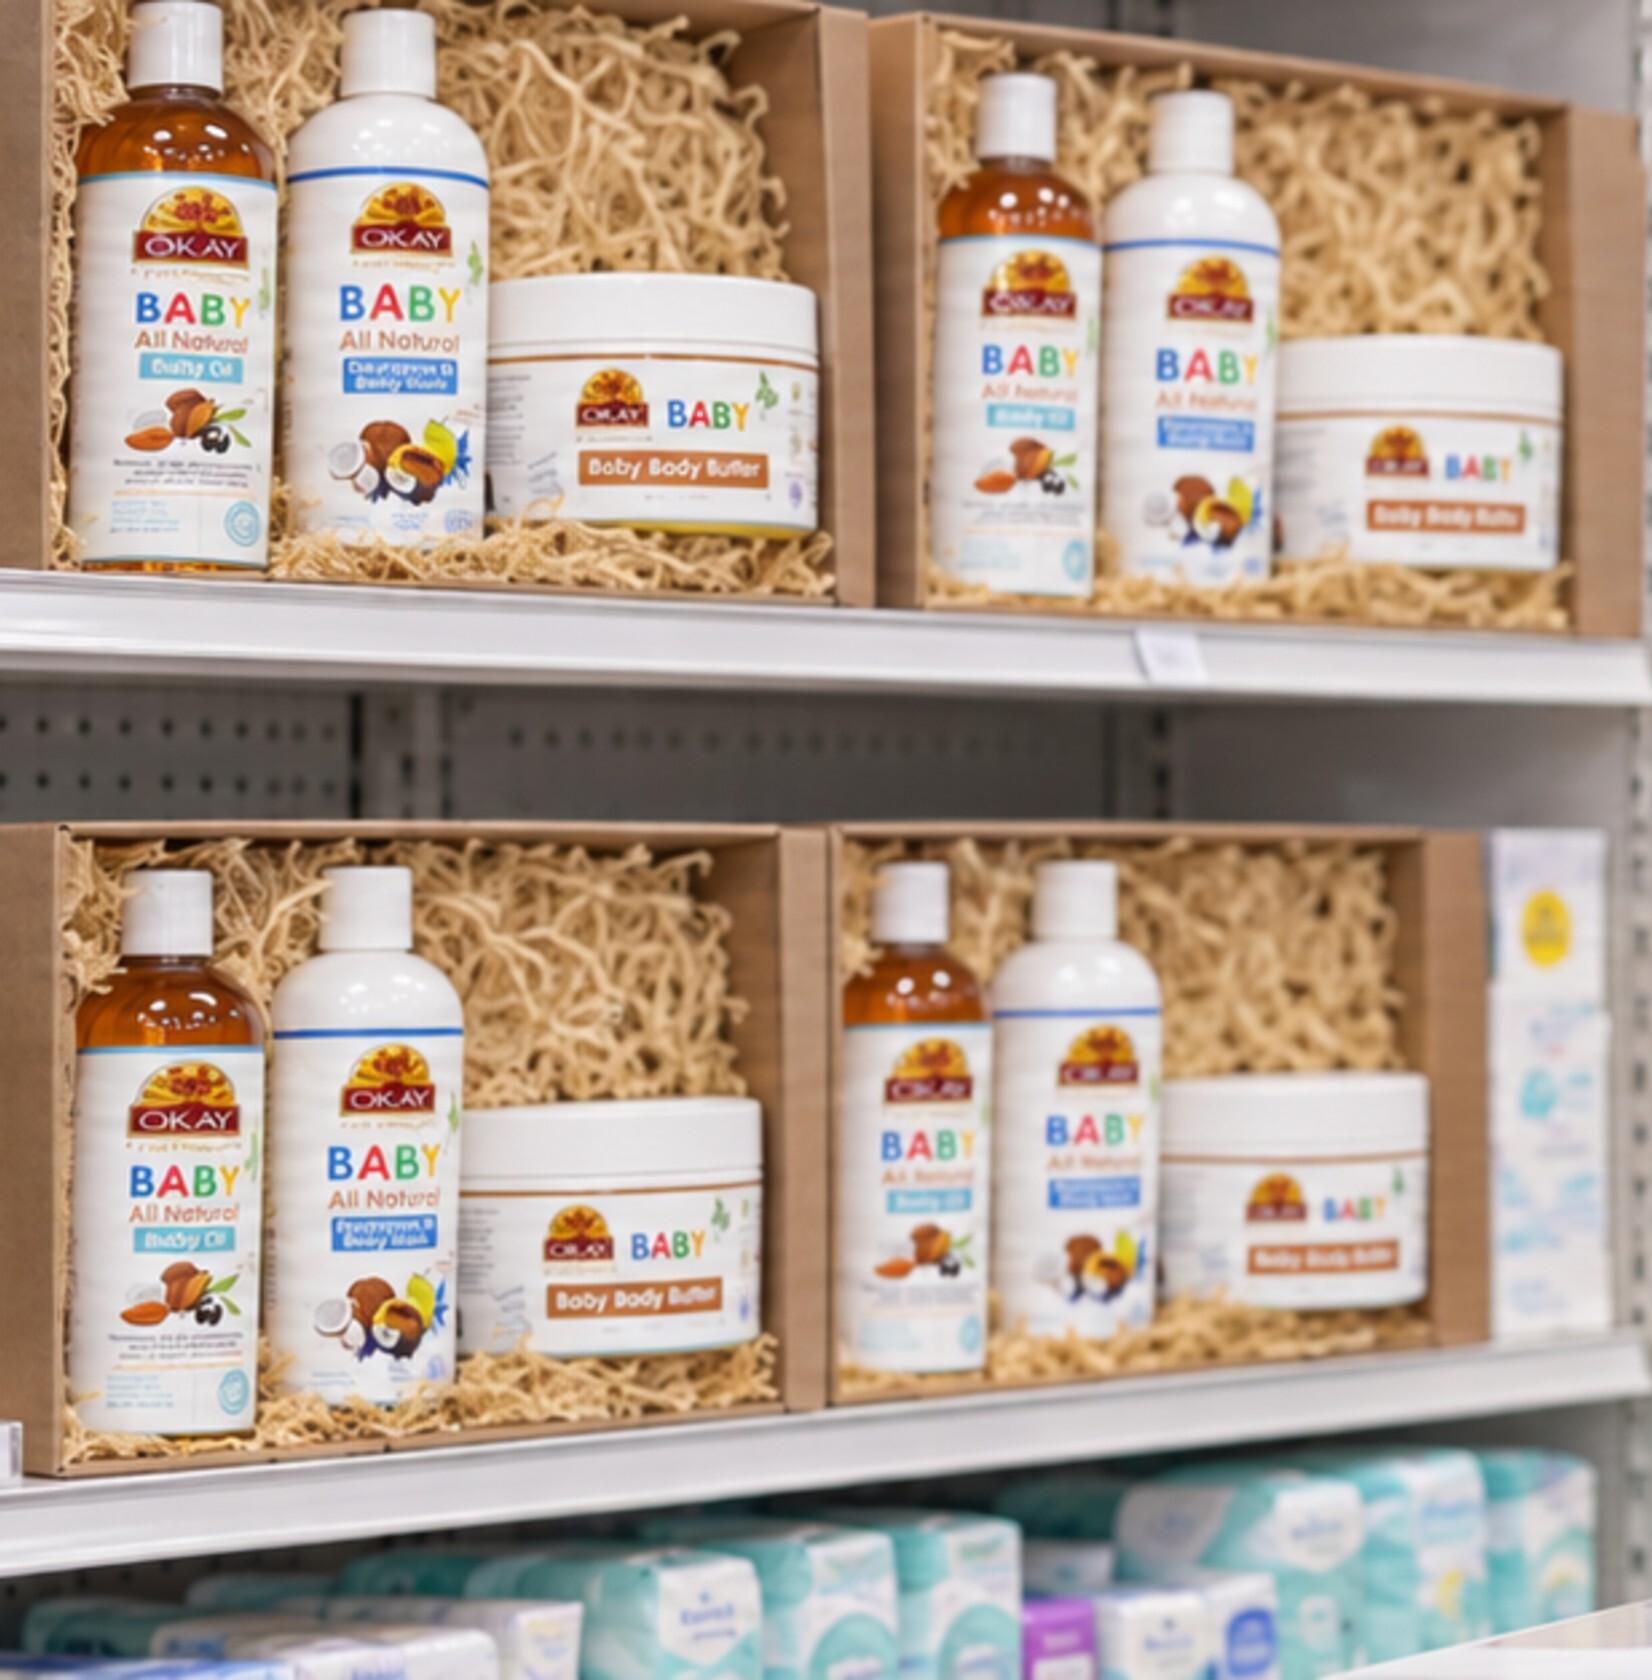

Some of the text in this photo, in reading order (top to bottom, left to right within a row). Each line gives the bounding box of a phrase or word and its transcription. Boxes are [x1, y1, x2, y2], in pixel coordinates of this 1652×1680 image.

[144, 235, 240, 258] OKAY
[361, 229, 444, 248] OKAY
[136, 292, 250, 327] BABY
[340, 283, 461, 323] BABY
[134, 330, 248, 354] All Natural
[339, 330, 460, 353] All Natural
[982, 343, 1080, 378] BABY
[1156, 348, 1258, 386] BABY
[667, 399, 749, 431] BABY
[588, 458, 643, 480] Baby
[649, 458, 702, 480] Body
[1445, 454, 1512, 484] BABY
[350, 1089, 429, 1109] OKAY
[138, 1110, 232, 1130] OKAY
[1046, 1114, 1144, 1146] BABY
[881, 1129, 974, 1162] BABY
[327, 1144, 441, 1181] BABY
[130, 1165, 240, 1198] BABY
[328, 1187, 441, 1209] All Natural
[1323, 1196, 1386, 1223] BABY
[129, 1202, 240, 1223] All Natural
[631, 1230, 705, 1261] BABY
[556, 1291, 608, 1313] Baby
[614, 1288, 664, 1309] Body
